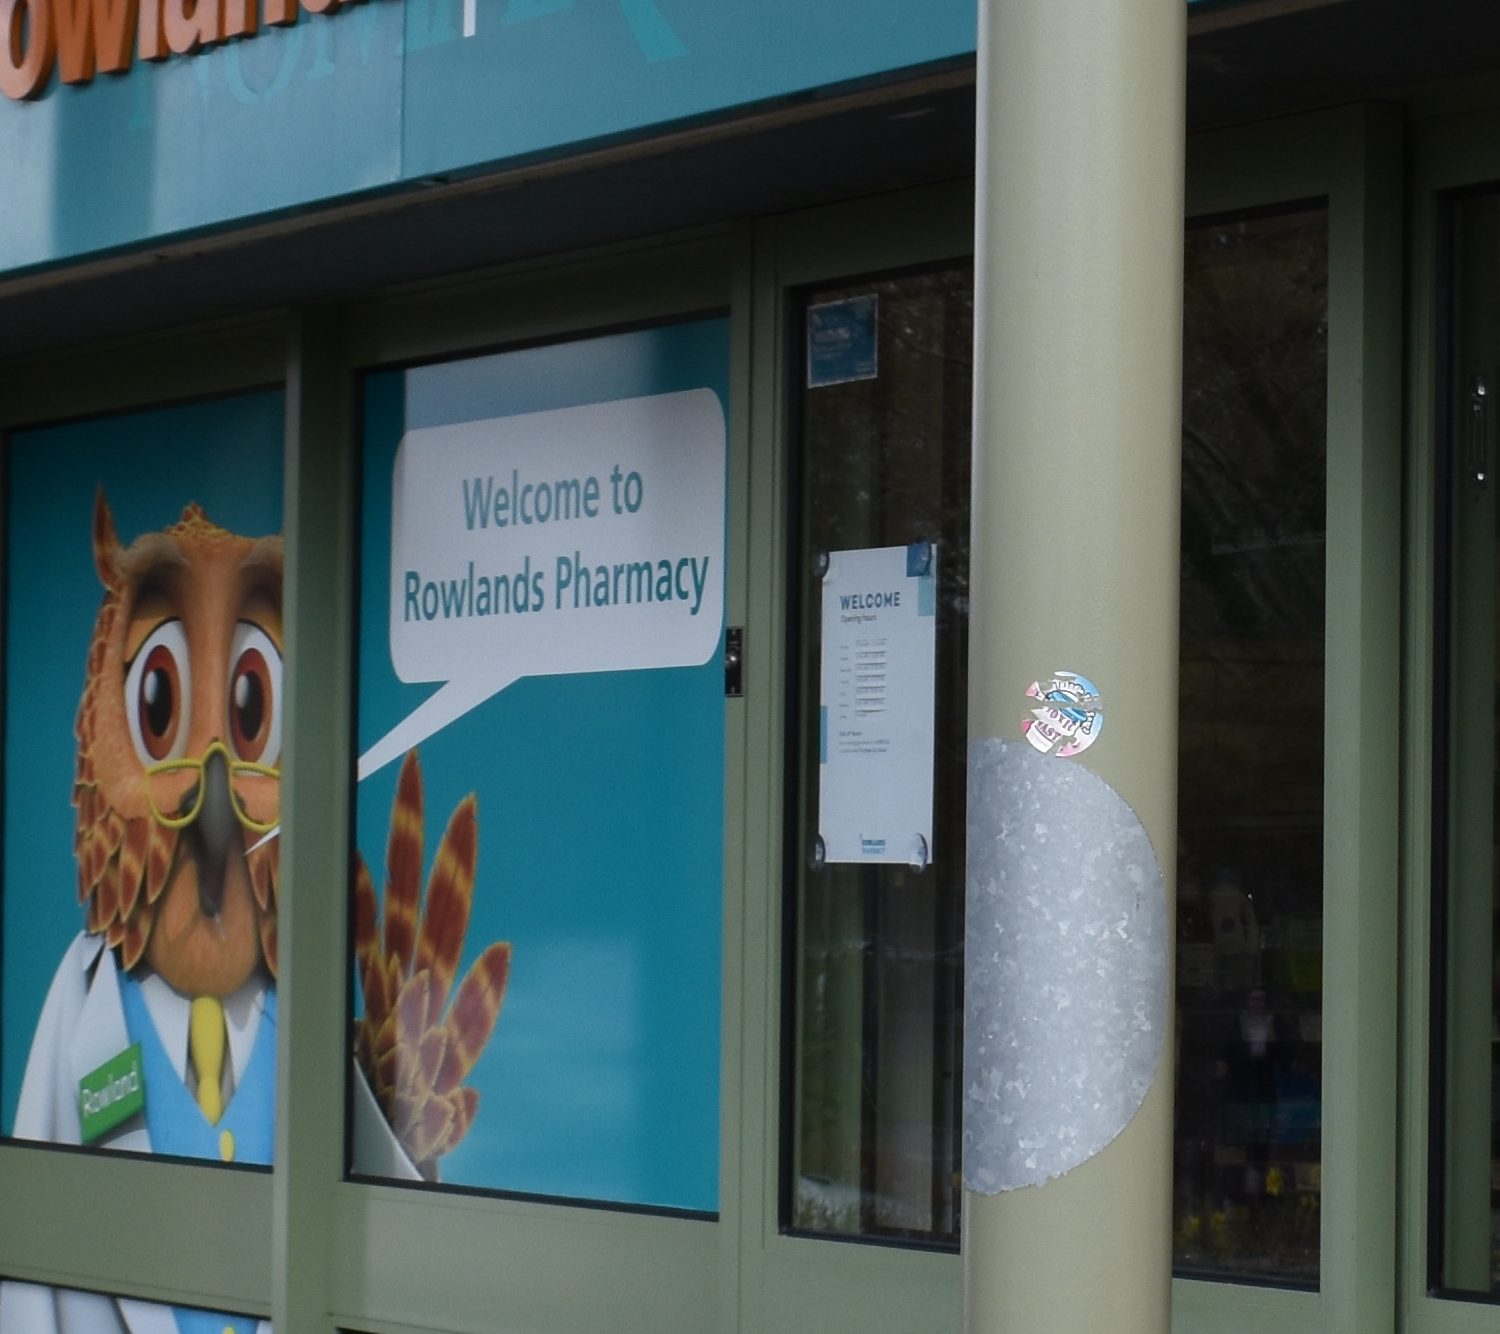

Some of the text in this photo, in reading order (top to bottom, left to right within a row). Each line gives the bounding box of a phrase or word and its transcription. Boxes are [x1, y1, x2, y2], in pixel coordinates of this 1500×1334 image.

[462, 463, 644, 531] Welcome to
[403, 551, 710, 623] Rowlands Pharmacy
[839, 591, 901, 611] WELCOME
[81, 1061, 139, 1119] Rowland
